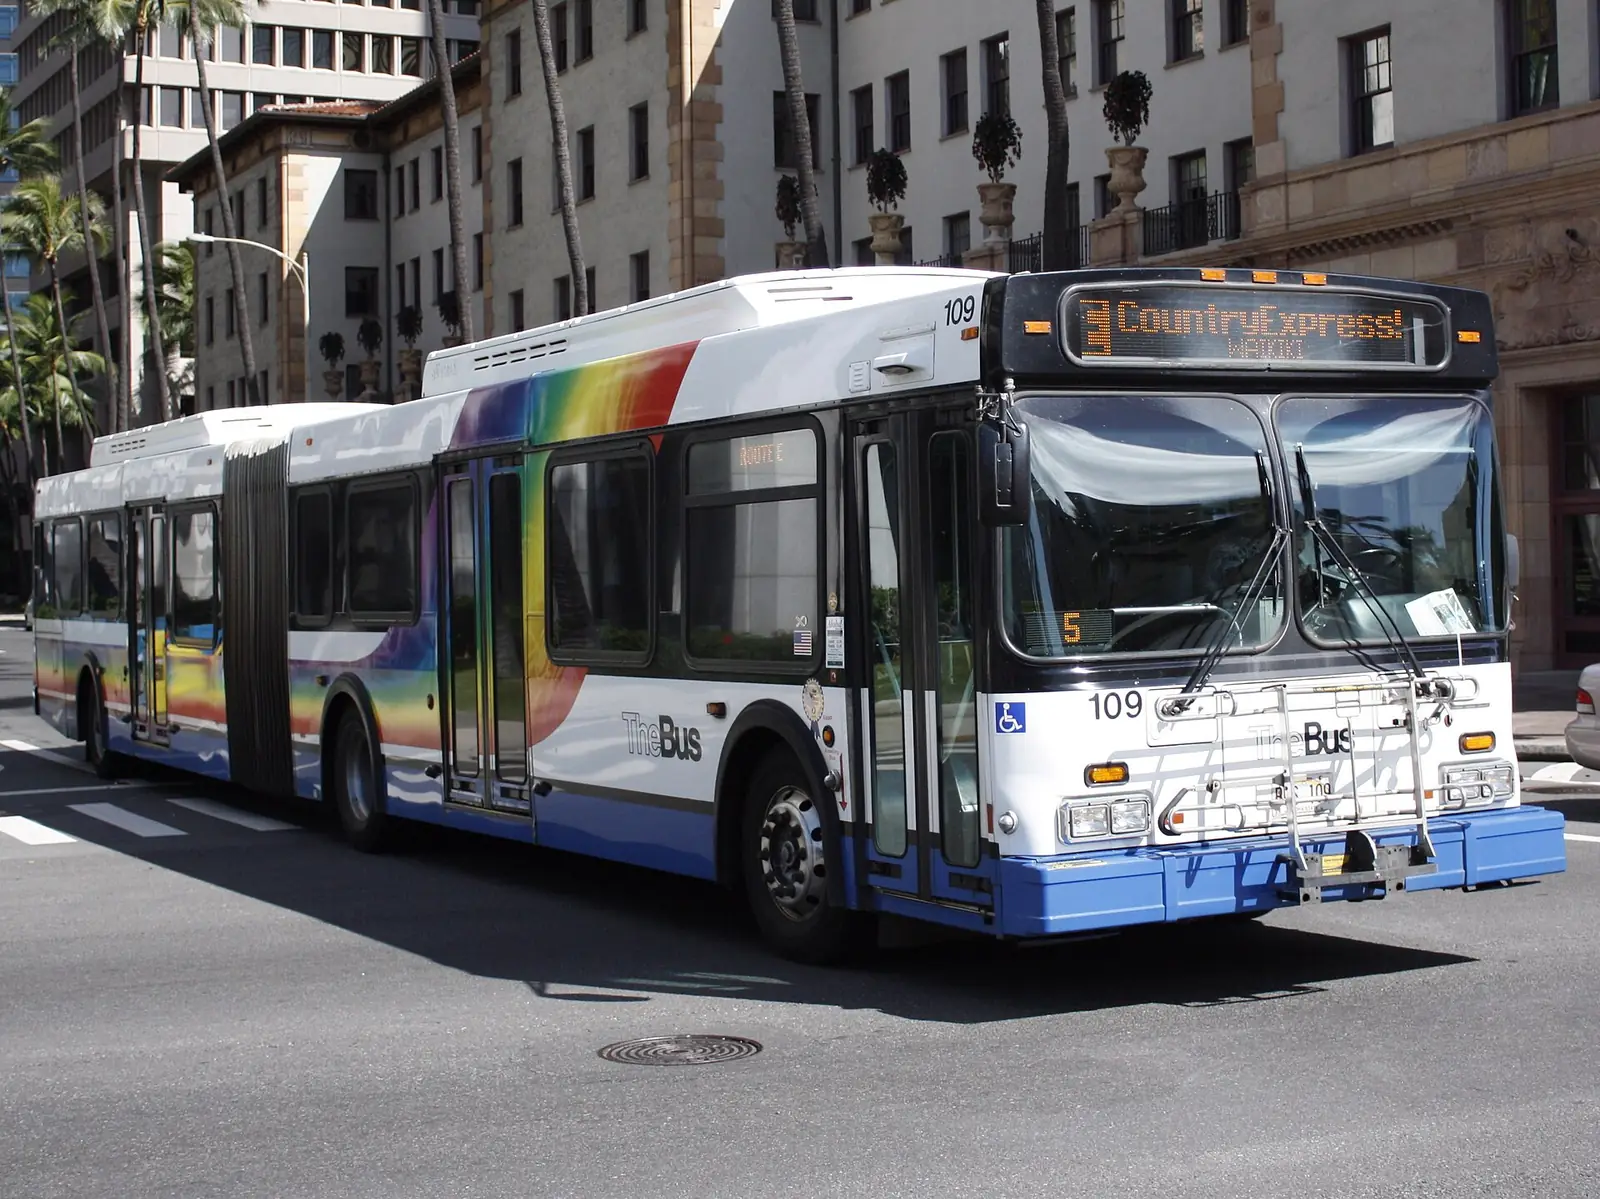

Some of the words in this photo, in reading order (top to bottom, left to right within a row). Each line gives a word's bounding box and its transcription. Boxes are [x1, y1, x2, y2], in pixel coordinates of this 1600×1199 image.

[944, 295, 975, 326] 109
[1117, 300, 1402, 338] CountryExpress!
[1228, 338, 1304, 359] WAIKIKI
[1063, 612, 1081, 643] 5
[1088, 690, 1143, 720] 109
[621, 711, 702, 762] TheBus
